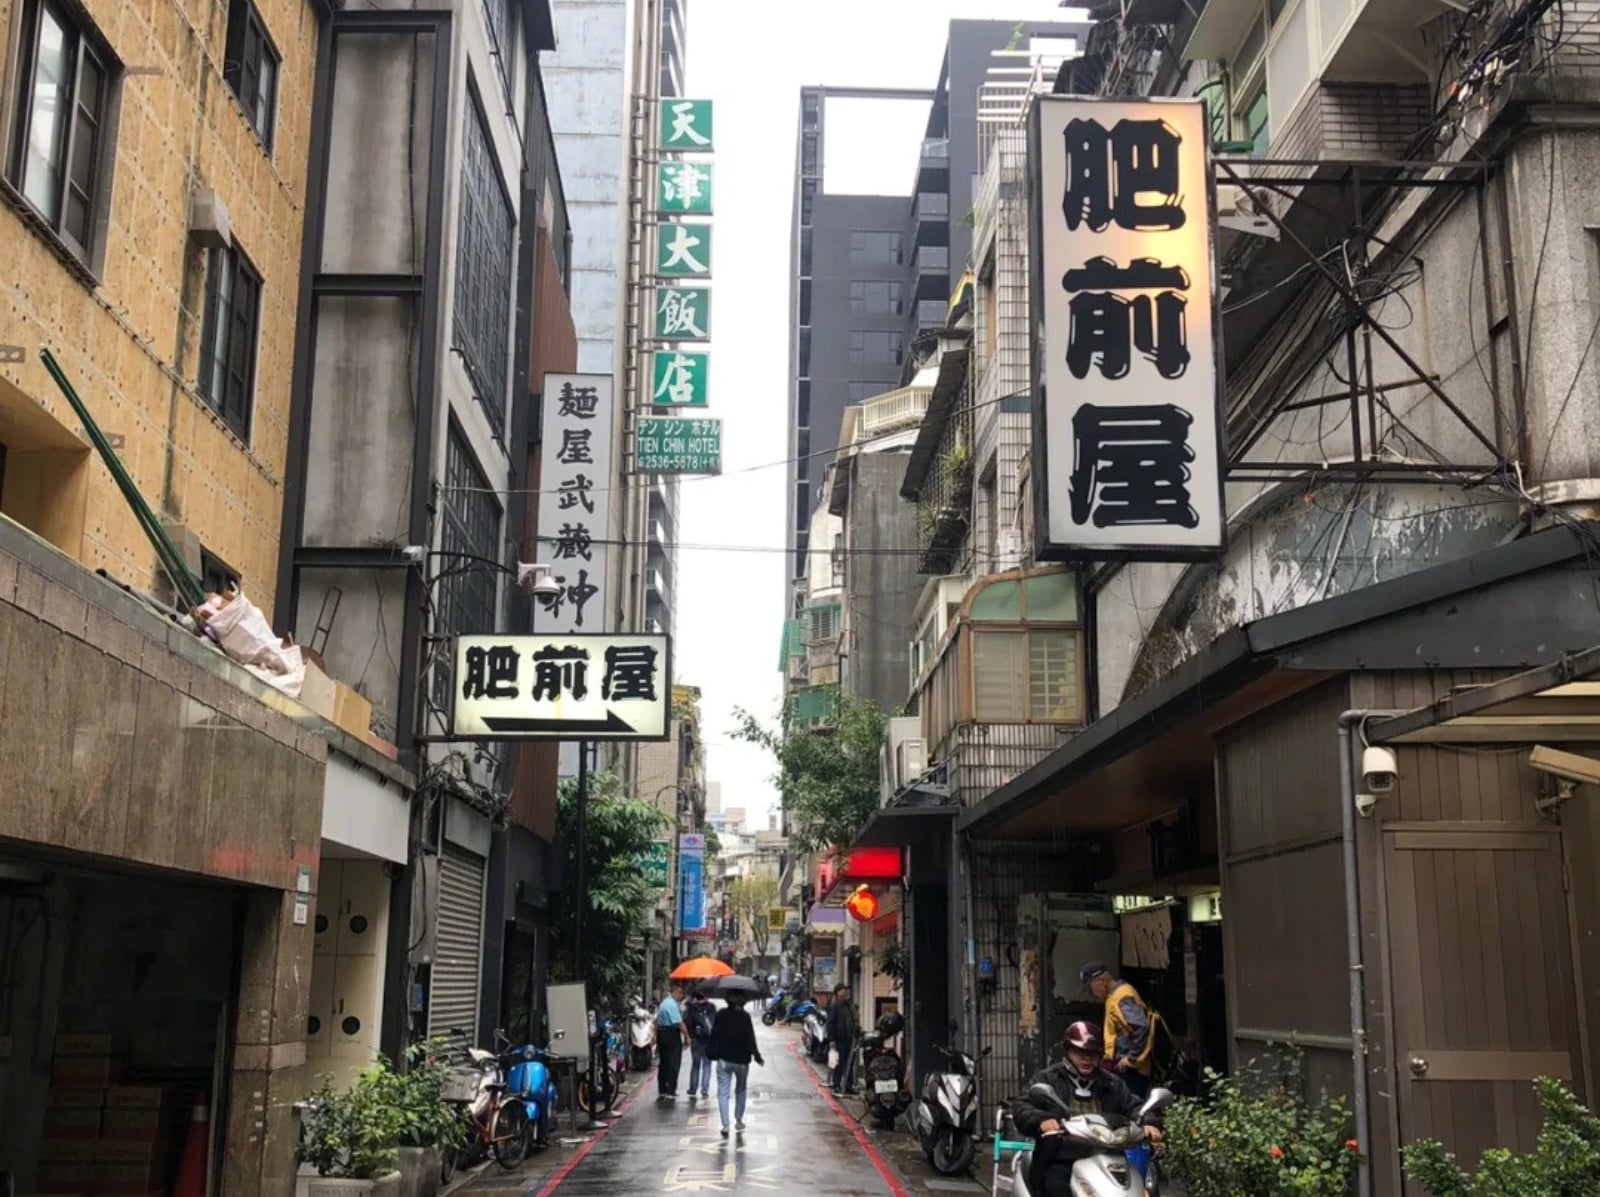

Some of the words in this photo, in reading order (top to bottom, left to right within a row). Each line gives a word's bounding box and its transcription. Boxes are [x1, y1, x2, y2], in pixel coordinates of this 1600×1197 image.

[654, 102, 711, 402] 天津大飯店
[1062, 117, 1200, 529] 肥前屋
[544, 381, 599, 633] 麺屋武蔵神
[663, 437, 685, 453] CHIN
[688, 437, 719, 454] HOTEL
[463, 644, 658, 702] 肥前屋
